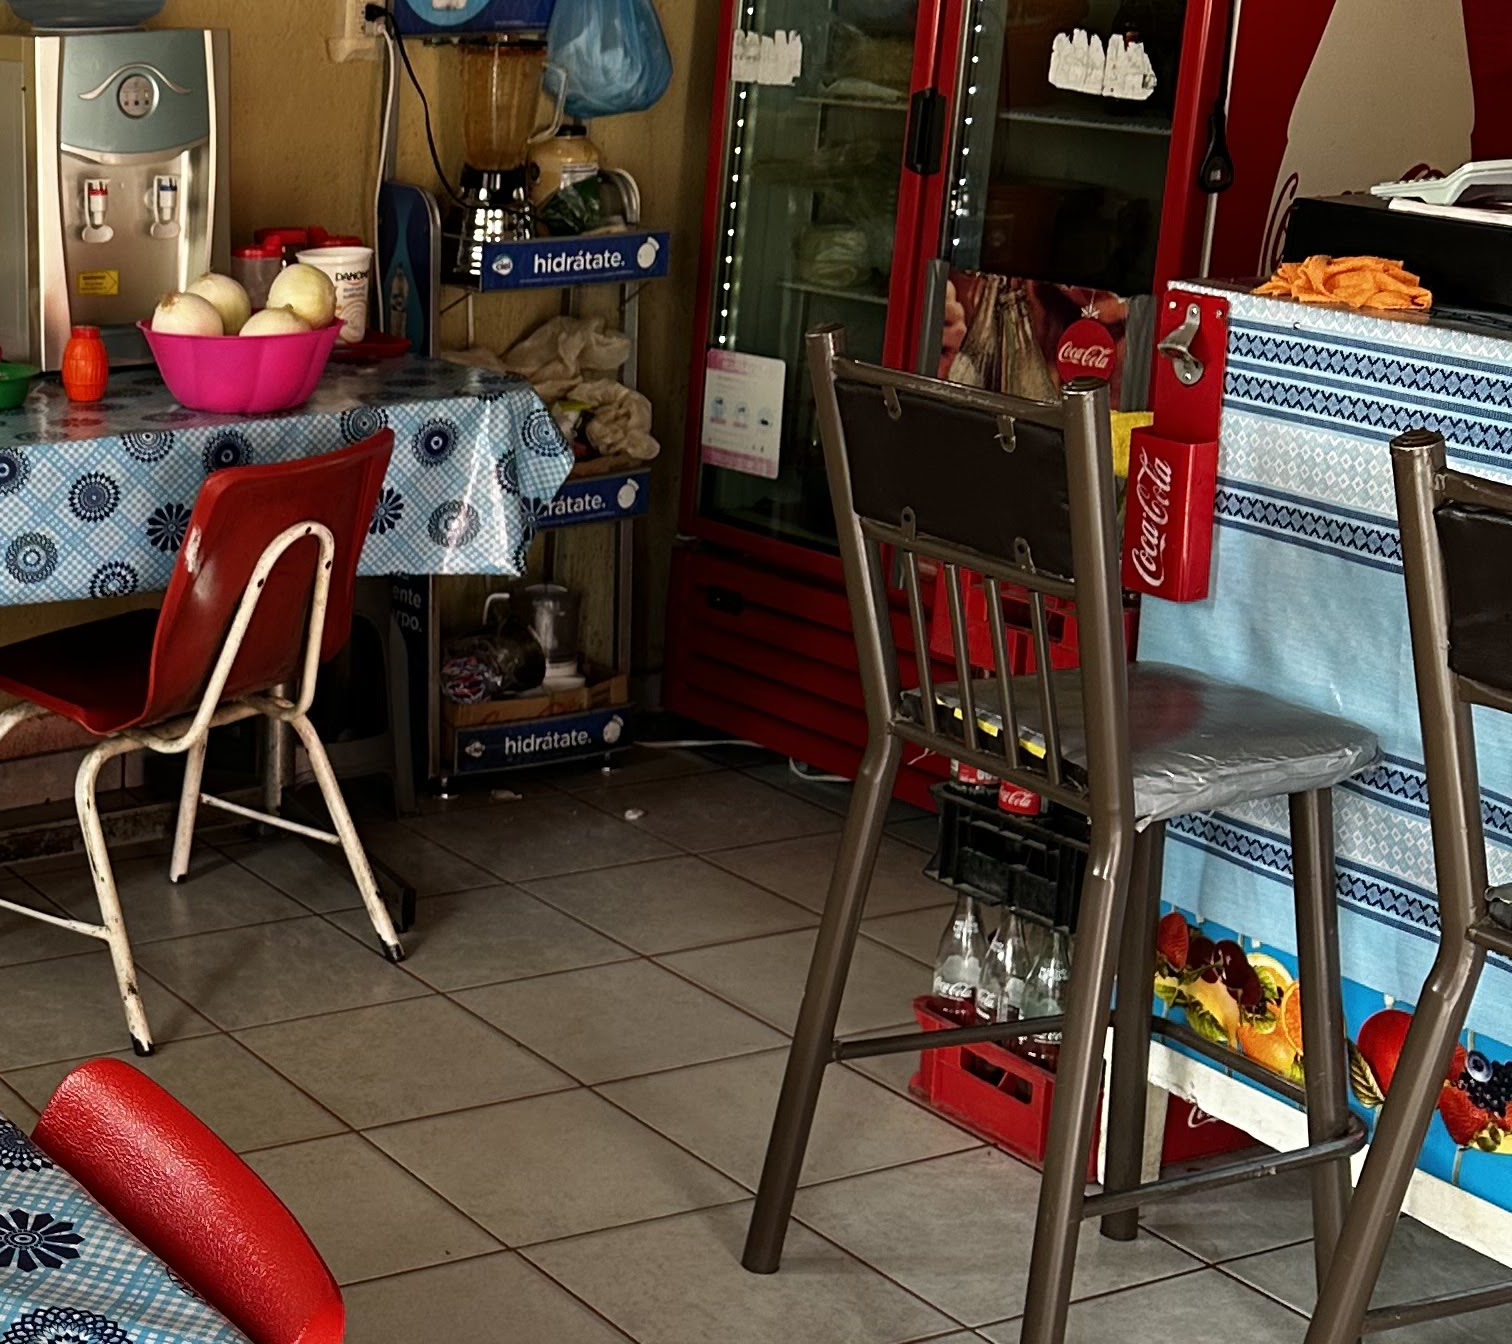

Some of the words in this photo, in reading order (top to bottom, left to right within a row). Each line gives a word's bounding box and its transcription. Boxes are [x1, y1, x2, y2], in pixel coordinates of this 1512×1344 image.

[534, 250, 625, 274] hidrátate.
[1058, 341, 1114, 368] Coca-Cola
[1132, 446, 1172, 586] Coca-Cola
[392, 585, 421, 606] ente
[505, 730, 591, 755] hidrátate.
